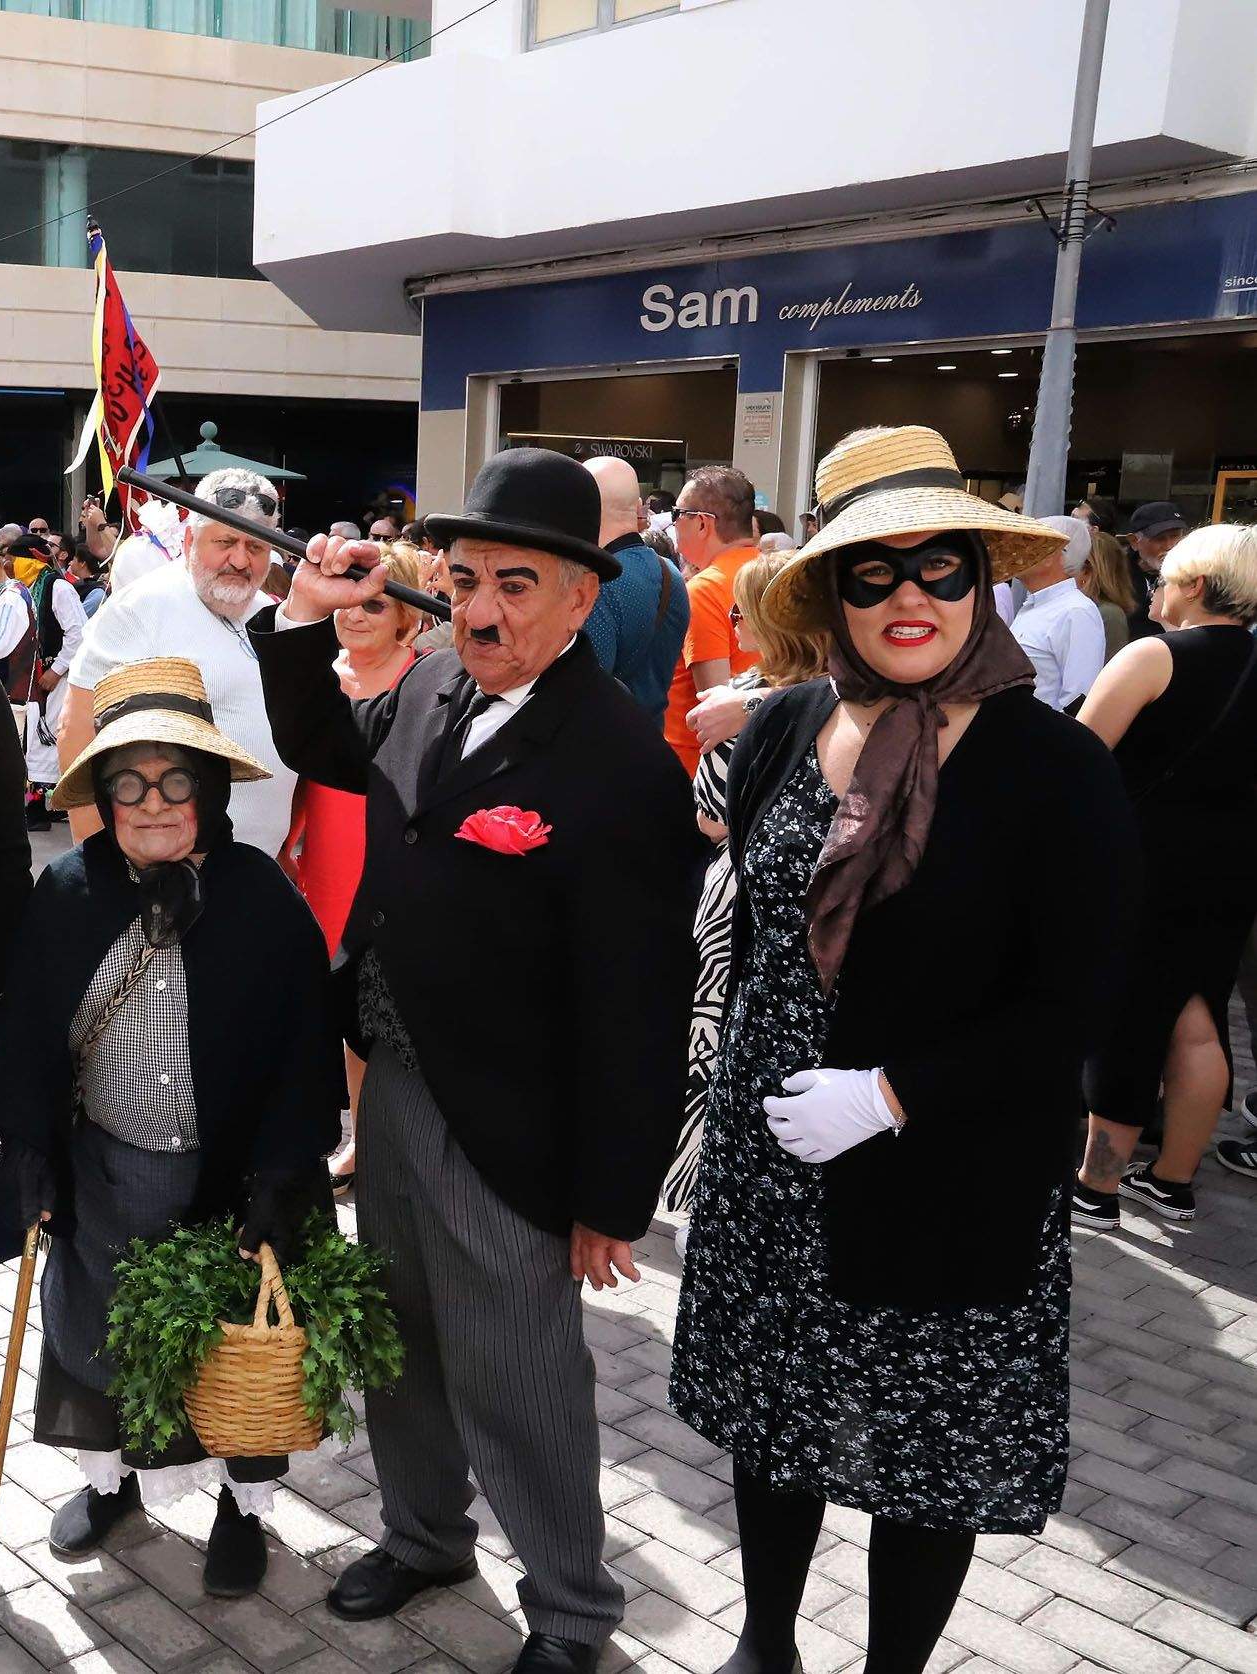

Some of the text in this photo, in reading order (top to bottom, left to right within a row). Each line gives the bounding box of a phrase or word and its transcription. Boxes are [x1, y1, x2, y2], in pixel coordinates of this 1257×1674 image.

[640, 282, 923, 332] Sam complements
[590, 443, 654, 459] SWAROVSKI
